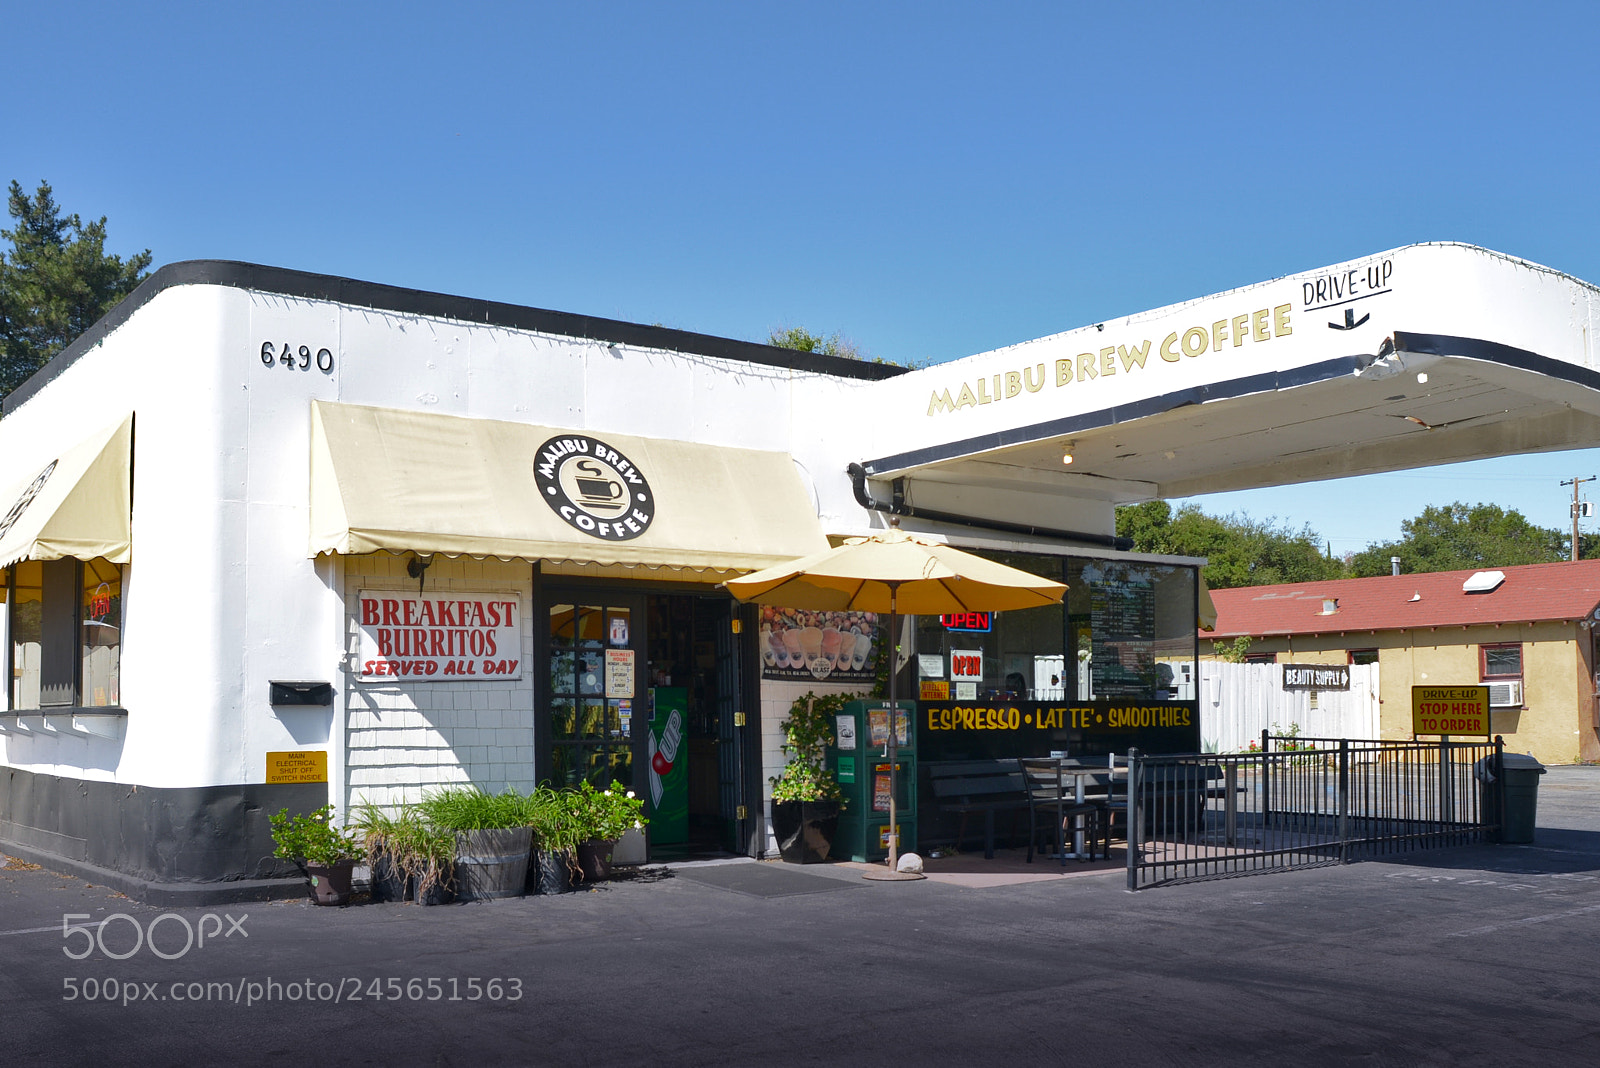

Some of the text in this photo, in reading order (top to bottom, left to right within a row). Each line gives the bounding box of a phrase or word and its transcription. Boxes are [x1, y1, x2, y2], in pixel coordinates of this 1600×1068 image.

[1303, 260, 1392, 305] DRIVE-UP
[261, 341, 333, 373] 6490
[927, 303, 1292, 416] MALIBU BREW COFFEE
[538, 439, 643, 484] MALIBU BREW
[560, 505, 649, 537] COFFEE
[361, 598, 517, 627] BREAKFAST
[942, 612, 988, 629] OPEN
[377, 628, 497, 657] BURRITOS
[362, 659, 519, 676] SERVED ALL DAY
[952, 655, 981, 676] OPEN
[921, 683, 947, 691] WIRELESS
[1286, 669, 1340, 685] BEAUTY SUPPLY
[921, 691, 946, 699] INTERNET
[1422, 689, 1478, 699] DRIVE-UP
[928, 706, 1020, 730] ESPRESSO
[1108, 706, 1191, 728] SMOOTHIES
[1419, 702, 1482, 715] STOP HERE
[1421, 718, 1482, 731] TO ORDER
